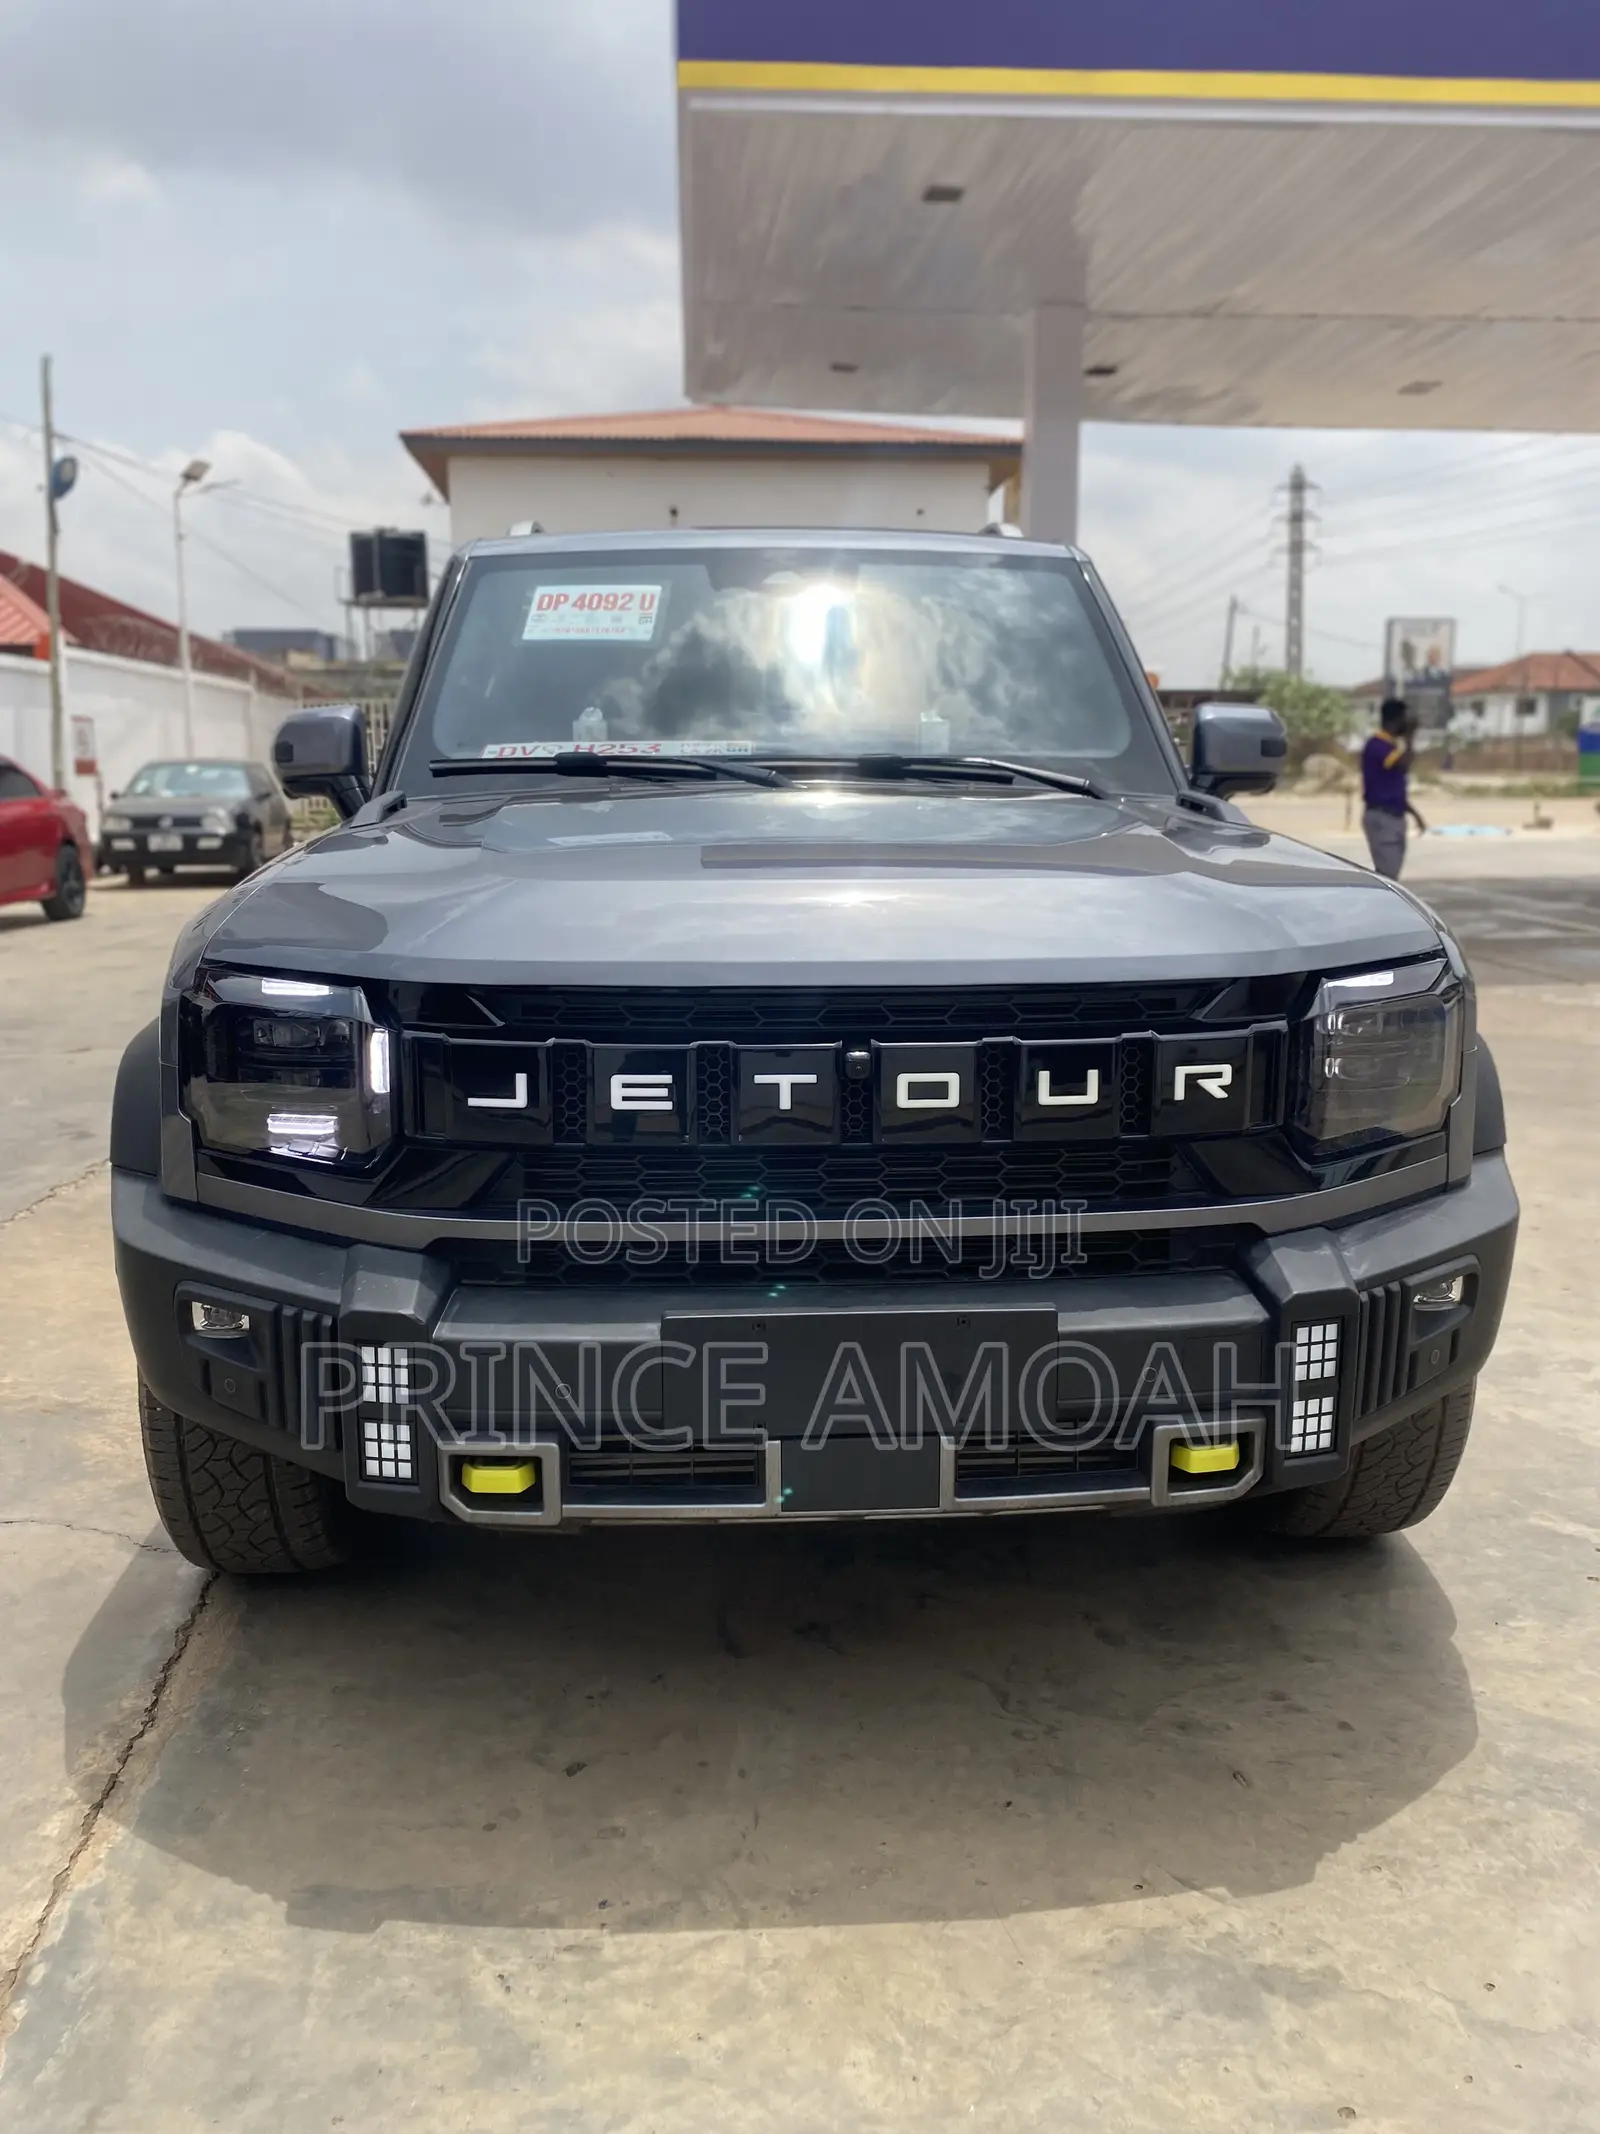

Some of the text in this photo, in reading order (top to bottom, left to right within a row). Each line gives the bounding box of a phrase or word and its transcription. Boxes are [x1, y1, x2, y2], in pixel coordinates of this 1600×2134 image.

[536, 592, 655, 611] DP 4092 U
[467, 1063, 1233, 1110] JETOUR
